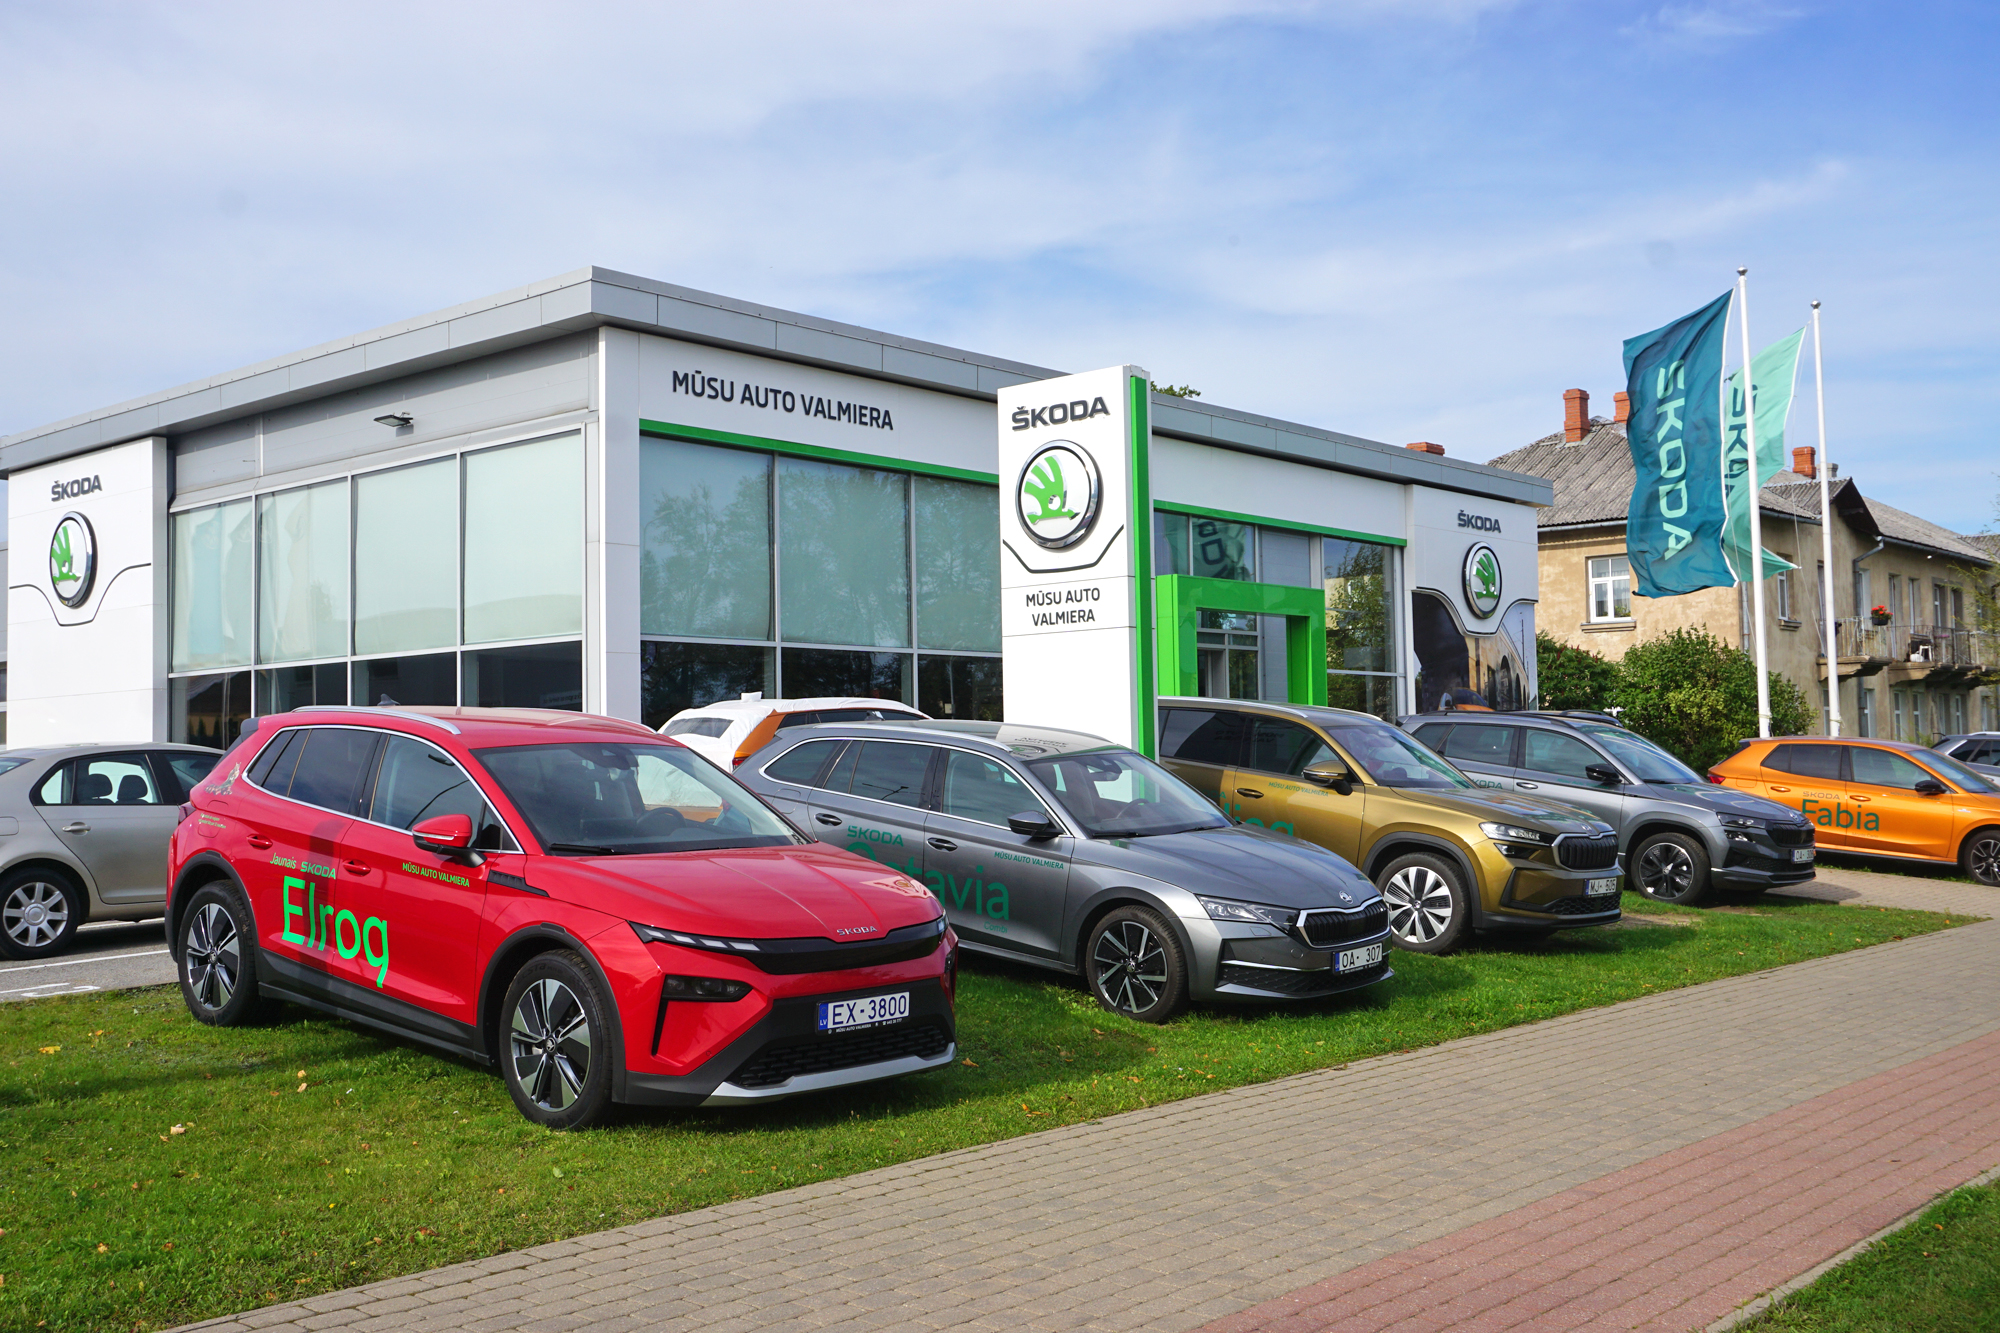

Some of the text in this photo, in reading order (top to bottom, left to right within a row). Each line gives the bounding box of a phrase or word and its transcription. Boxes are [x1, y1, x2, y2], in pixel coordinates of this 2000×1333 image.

[672, 370, 894, 431] MŪSU AUTO VALMIERA
[1011, 396, 1110, 431] ŠKODA
[51, 474, 103, 502] ŠKODA
[1457, 509, 1502, 534] ŠKODA
[1026, 587, 1100, 607] MŪSU AUTO
[1031, 608, 1096, 627] VALMIERA
[1802, 799, 1879, 832] Fabia
[269, 853, 297, 870] Jaunais
[1013, 854, 1031, 864] AUTO
[1032, 858, 1064, 870] VALMIERA
[420, 867, 438, 879] AUTO
[438, 871, 470, 888] VALMIERA
[281, 875, 390, 989] Elroq
